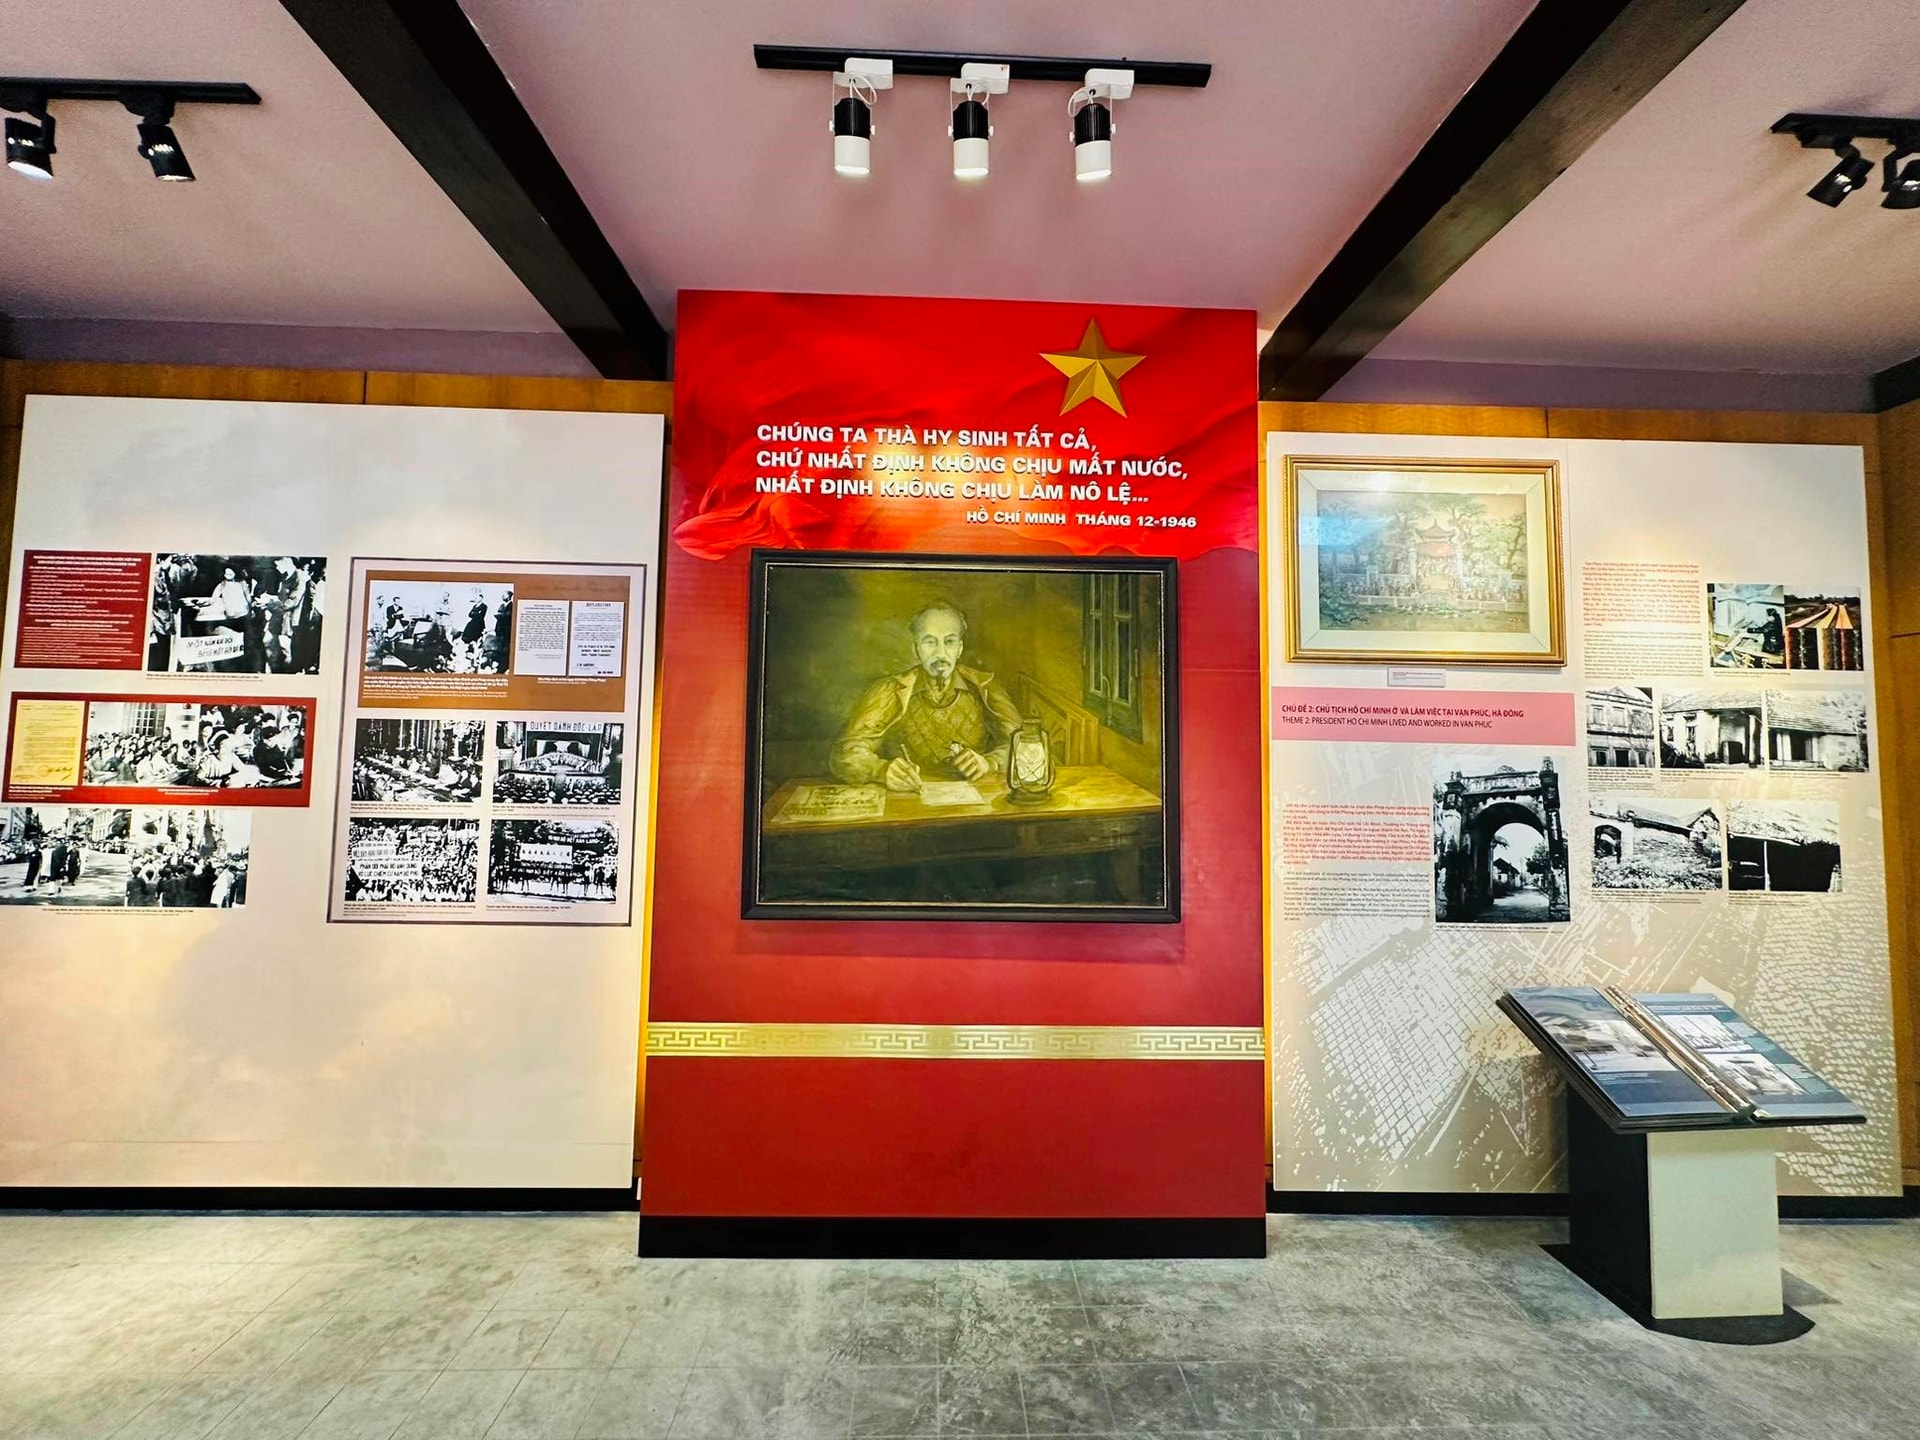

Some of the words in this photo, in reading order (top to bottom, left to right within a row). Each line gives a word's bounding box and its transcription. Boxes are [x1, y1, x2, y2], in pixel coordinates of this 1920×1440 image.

[757, 421, 834, 443] CHÚNG
[839, 426, 868, 444] TA
[874, 423, 918, 446] THÀ
[923, 429, 953, 446] HY
[957, 429, 1008, 448] SINH
[1013, 423, 1054, 449] TẤT
[1059, 426, 1097, 453] CẢ,
[756, 447, 803, 468] CHỨ
[807, 446, 866, 470] NHẤT
[871, 454, 925, 476] ĐỊNH
[931, 452, 1006, 475] KHÔNG
[1012, 456, 1062, 479] CHỊU
[1069, 451, 1116, 476] MẤT
[1121, 456, 1188, 481] NƯỚC,
[755, 470, 815, 494] NHẤT
[819, 477, 873, 500] ĐỊNH
[880, 479, 955, 500] KHÔNG
[961, 482, 1012, 504] CHỊU
[1018, 480, 1064, 502] LÀM
[1070, 481, 1101, 502] NÔ
[1107, 482, 1149, 506] LỆ...
[966, 505, 989, 524] HỒ
[993, 510, 1020, 525] CHÍ
[1024, 512, 1067, 526] MINH
[1075, 511, 1131, 527] THÁNG
[1137, 515, 1197, 528] 12-1946
[1282, 715, 1303, 724] THEME
[1312, 717, 1346, 726] PRESIDENT
[1347, 718, 1357, 726] HO
[1358, 718, 1370, 726] CHI
[1370, 718, 1388, 726] MINH
[1389, 718, 1407, 727] LIVED
[1408, 719, 1423, 727] AND
[1424, 719, 1451, 728] WORKED
[1452, 720, 1460, 728] IN
[1460, 720, 1474, 728] VAN
[1475, 720, 1492, 729] PHUC
[1372, 706, 1391, 715] MINH
